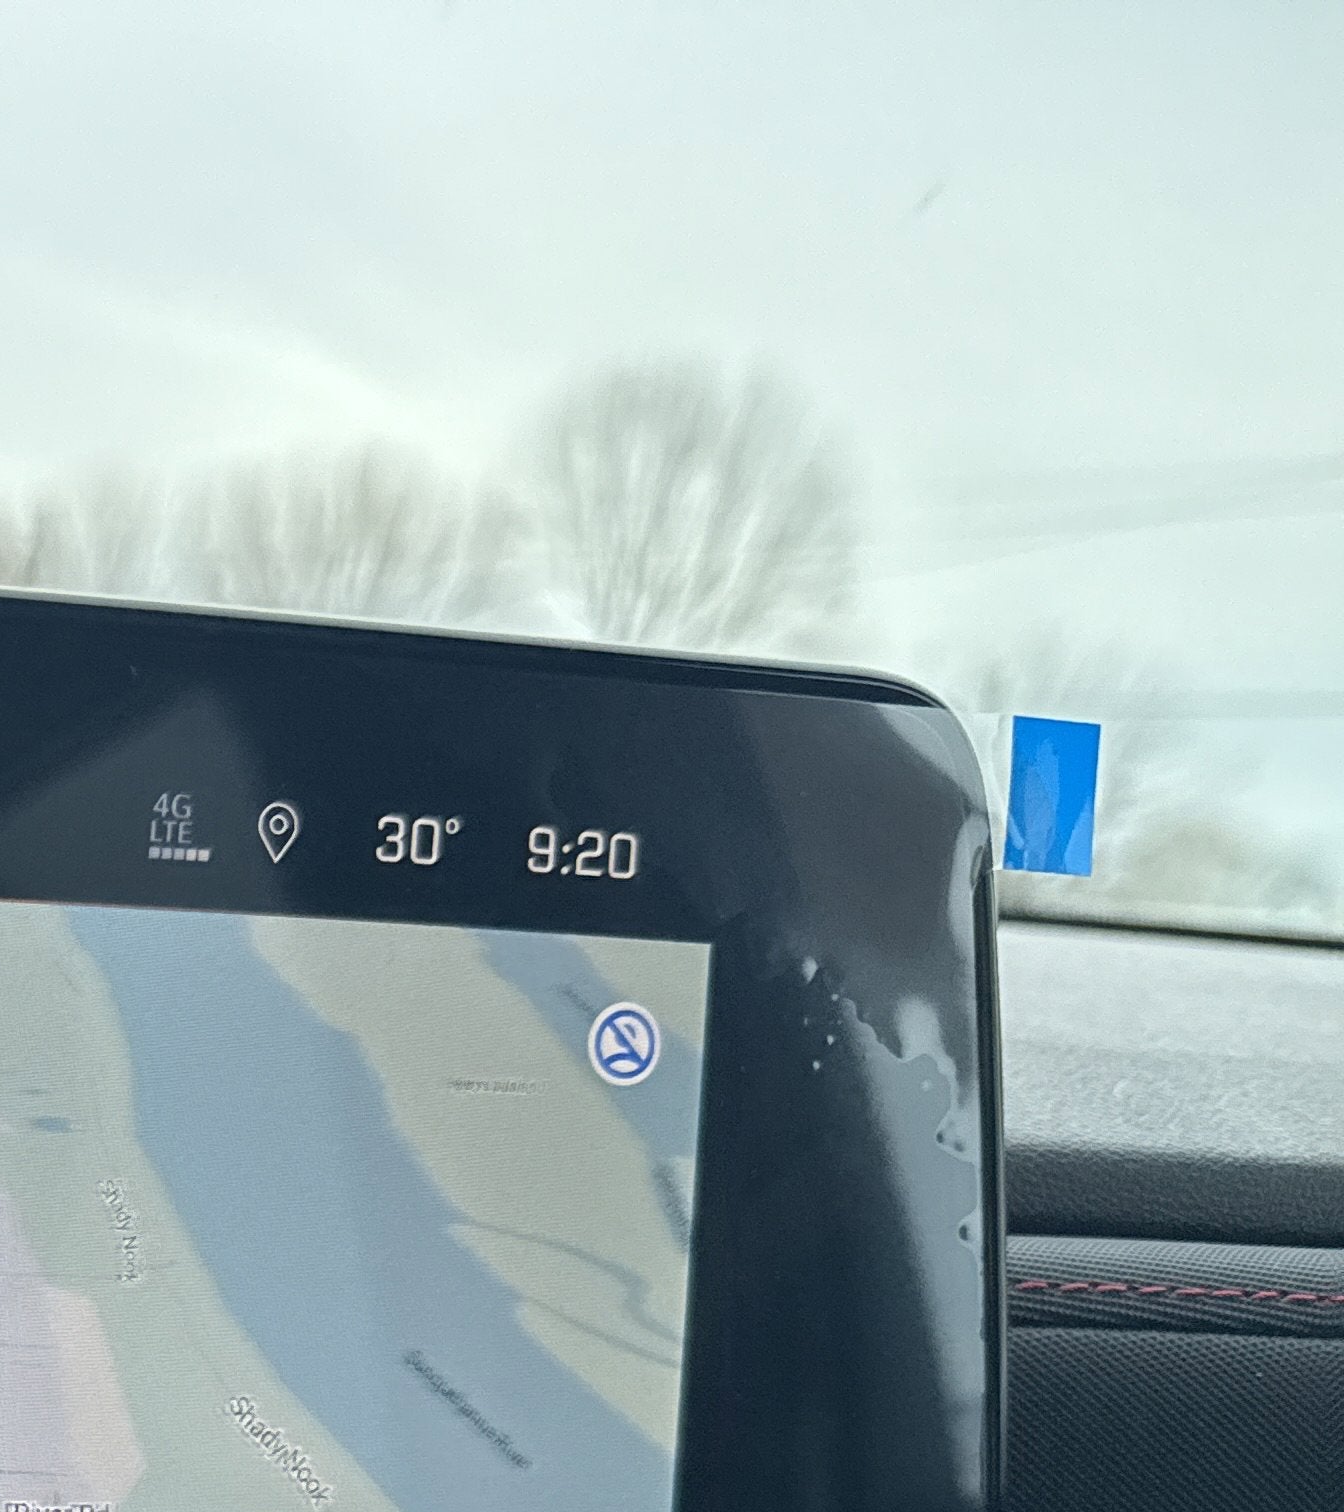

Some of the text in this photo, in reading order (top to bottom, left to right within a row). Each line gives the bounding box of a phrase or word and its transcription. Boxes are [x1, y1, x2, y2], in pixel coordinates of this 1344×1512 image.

[153, 792, 192, 819] 4G
[150, 820, 192, 843] LTE
[375, 815, 461, 865] 30°
[527, 826, 639, 880] 9:20
[230, 1396, 330, 1504] Shady Nook
